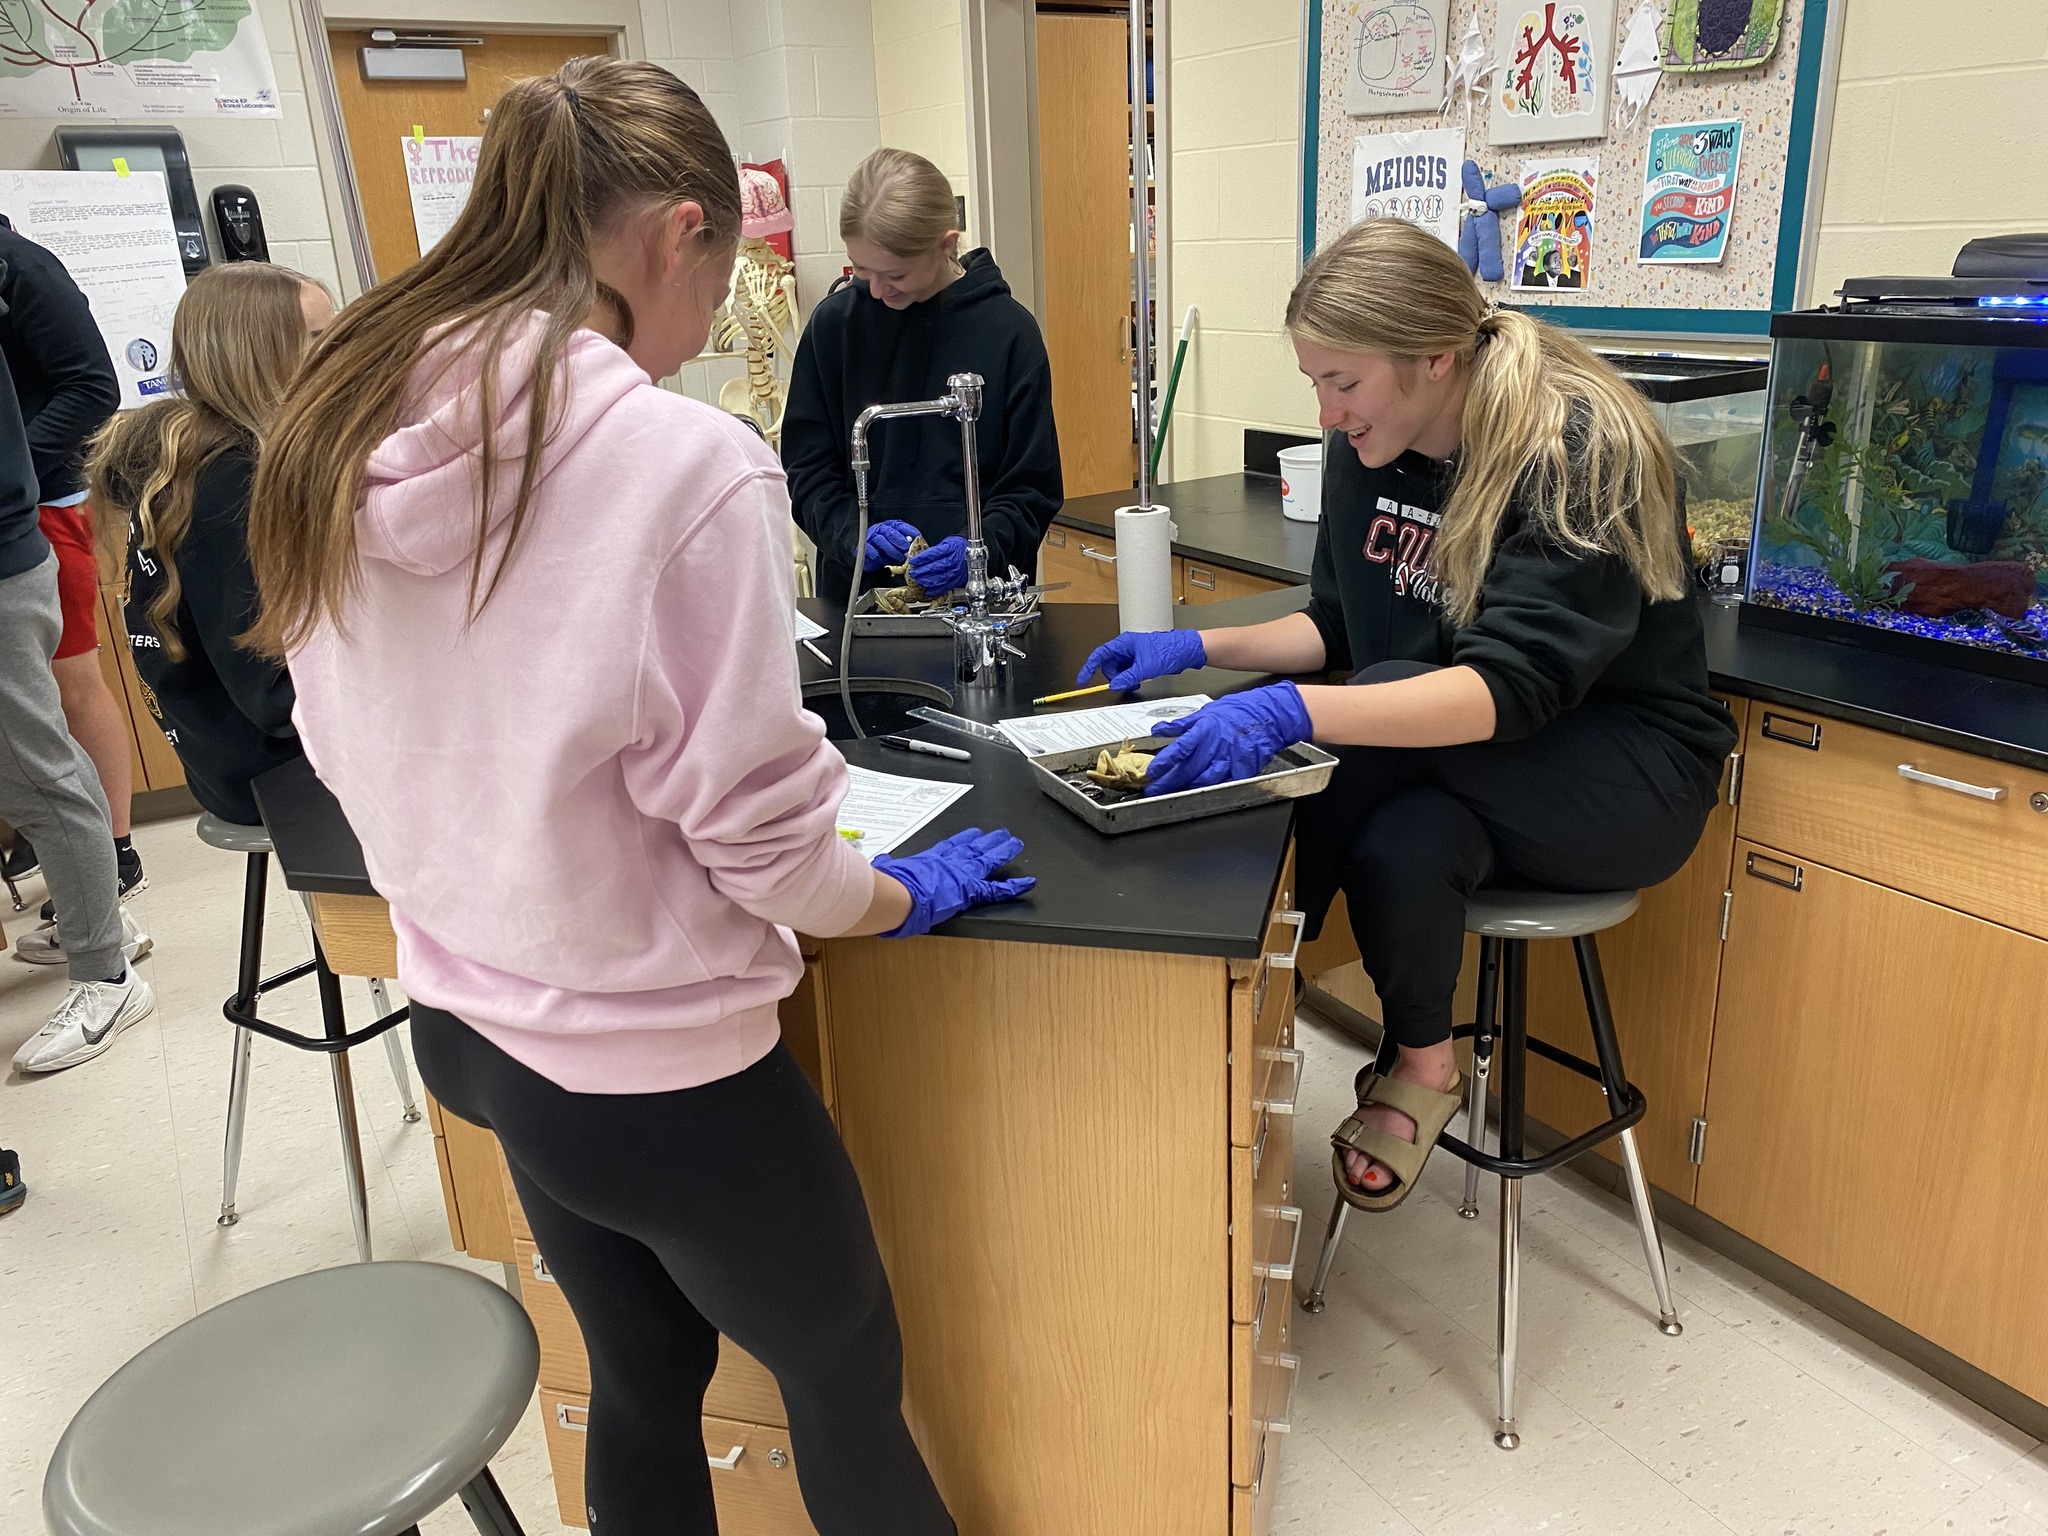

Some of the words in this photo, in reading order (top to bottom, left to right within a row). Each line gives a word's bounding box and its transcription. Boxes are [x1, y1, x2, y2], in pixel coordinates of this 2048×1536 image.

[57, 106, 81, 114] Origin
[425, 139, 480, 163] The
[1693, 130, 1711, 156] 3
[1709, 126, 1736, 153] WAYS
[1365, 155, 1447, 197] MEIOSIS
[1361, 514, 1440, 583] COU
[129, 634, 161, 649] TERS
